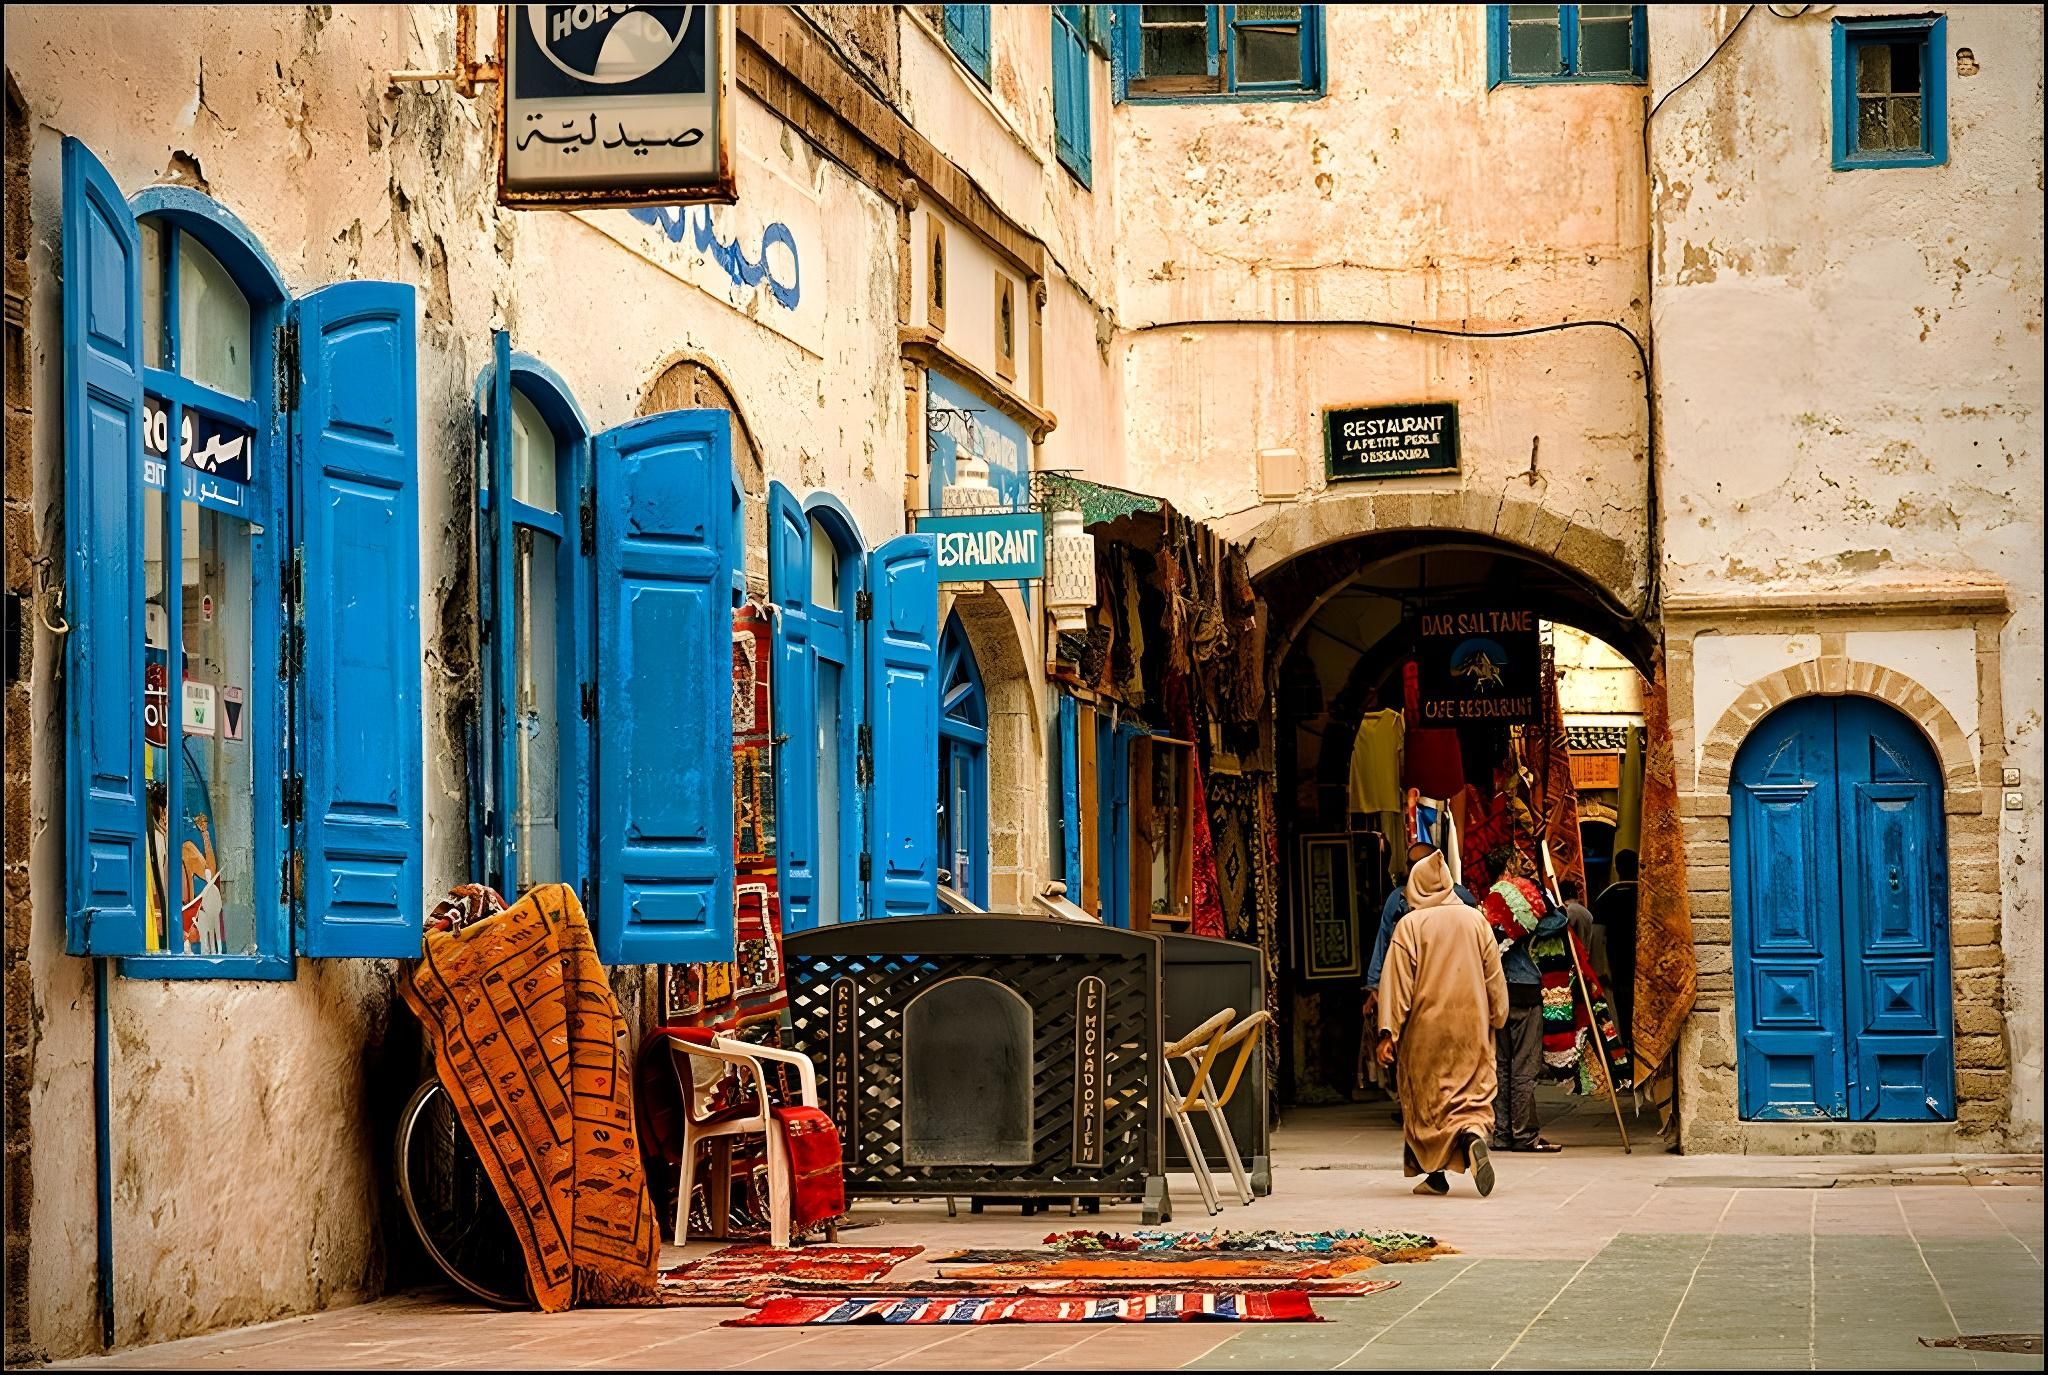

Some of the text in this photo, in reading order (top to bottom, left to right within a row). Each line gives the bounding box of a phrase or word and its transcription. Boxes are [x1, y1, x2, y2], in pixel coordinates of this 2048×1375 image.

[144, 405, 168, 453] RO
[1343, 416, 1444, 437] RESTAURANT
[1346, 439, 1361, 451] LA
[1362, 435, 1400, 449] PETITE
[937, 529, 1038, 567] ESTAURANT
[1422, 613, 1453, 636] DAR
